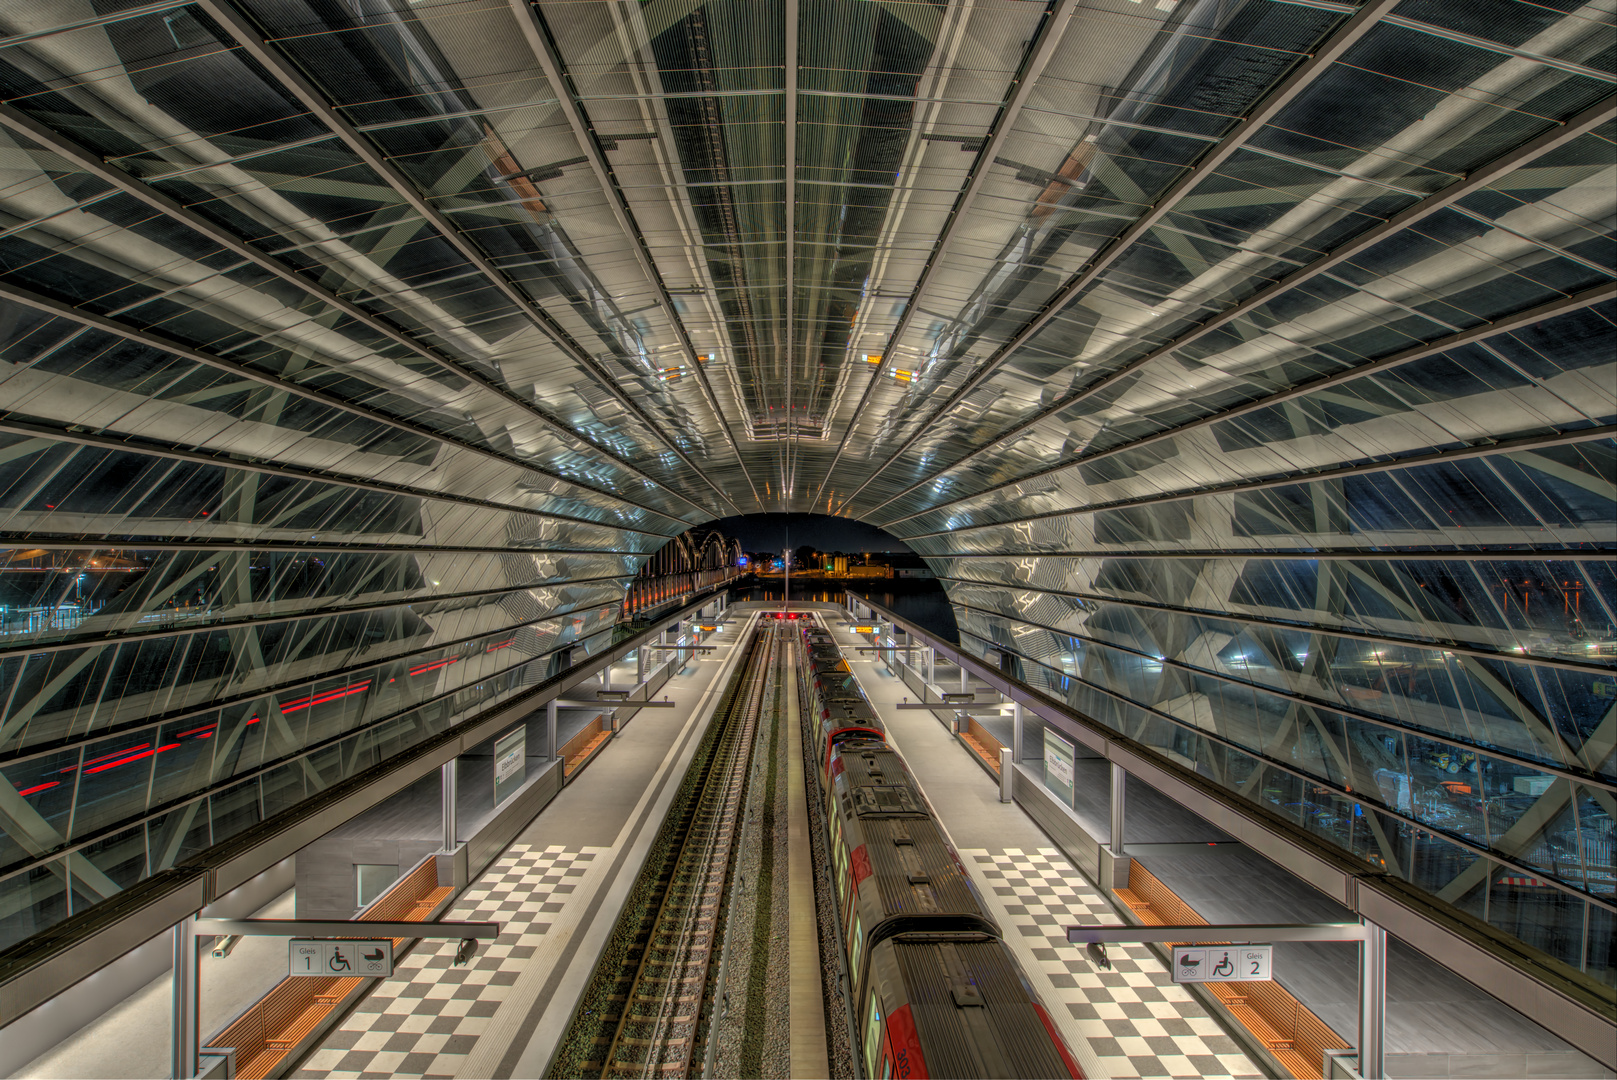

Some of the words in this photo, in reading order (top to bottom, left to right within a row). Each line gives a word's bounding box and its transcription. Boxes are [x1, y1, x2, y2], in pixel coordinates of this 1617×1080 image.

[299, 947, 316, 955] Gleis
[1246, 952, 1263, 960] Gleis
[304, 956, 311, 970] 1
[1250, 961, 1260, 975] 2
[897, 1048, 911, 1079] 303
